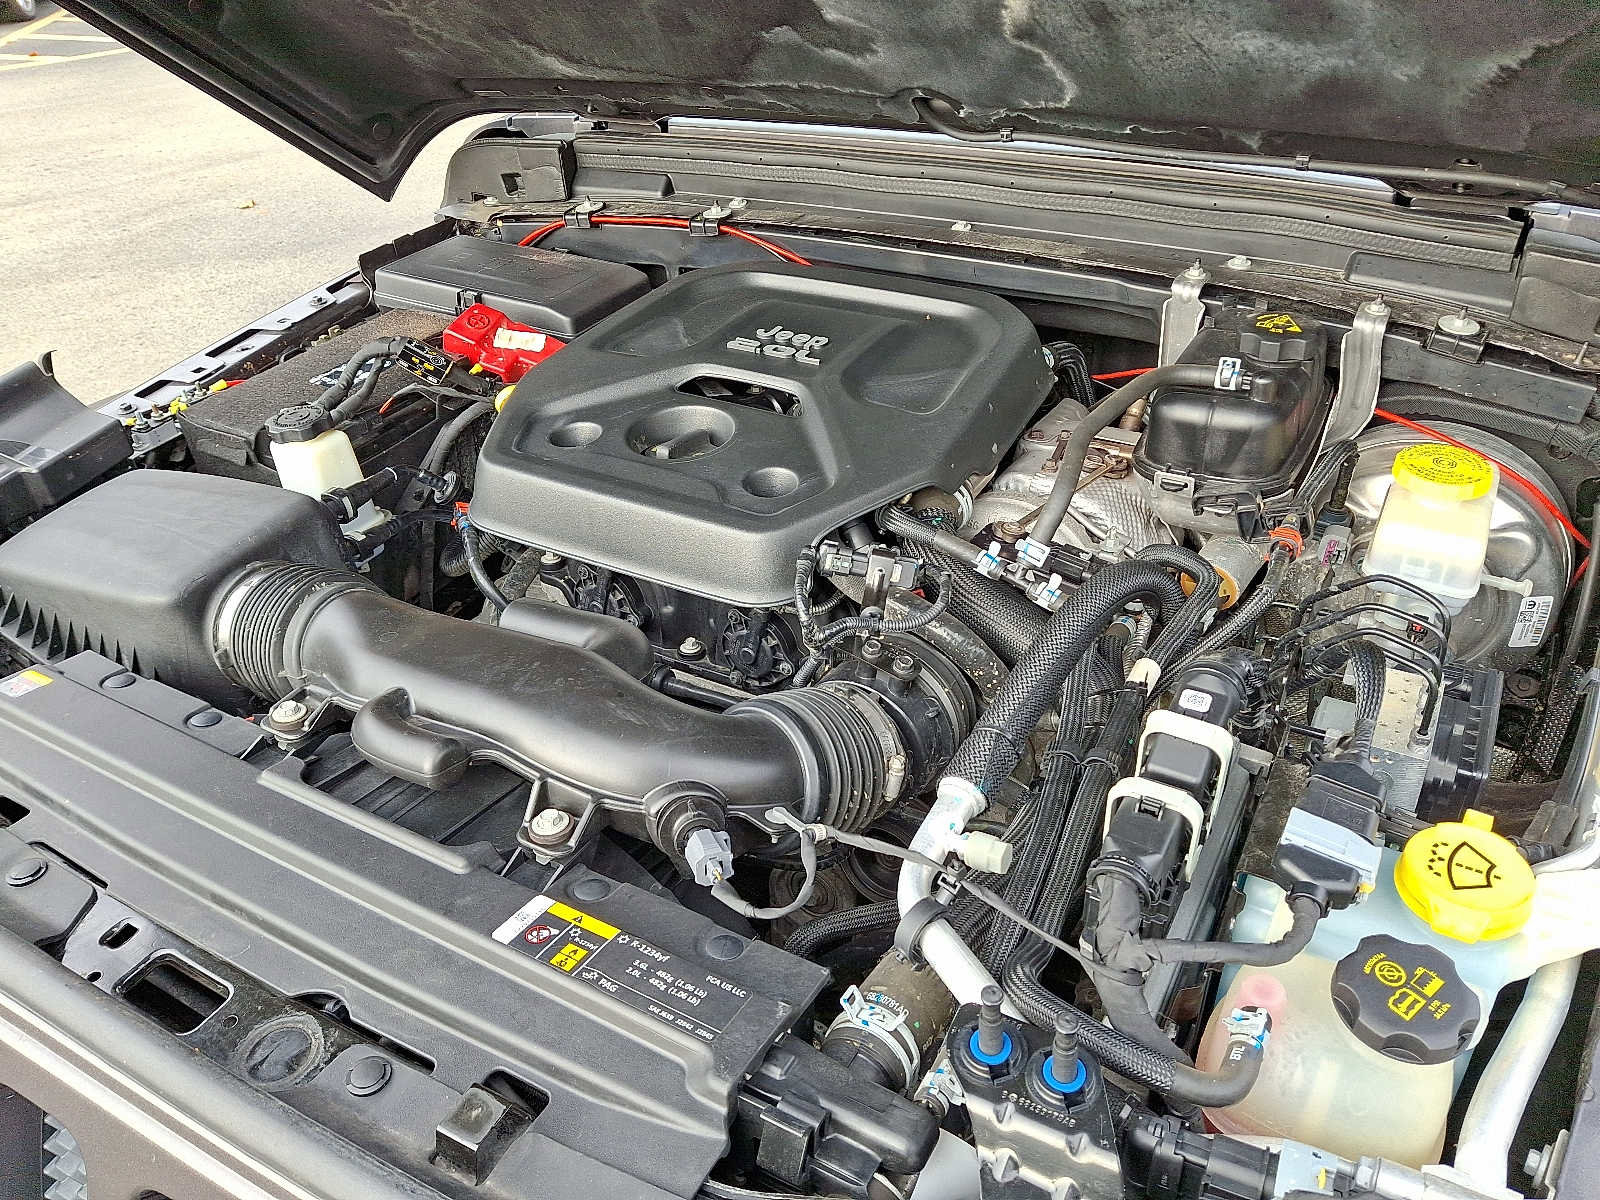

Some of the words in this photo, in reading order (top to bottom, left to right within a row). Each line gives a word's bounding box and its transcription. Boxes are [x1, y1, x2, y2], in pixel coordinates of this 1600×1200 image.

[756, 325, 829, 350] Jeep
[726, 337, 821, 366] 2.0L
[629, 938, 670, 963] R-1234yf
[597, 977, 619, 994] PAG
[625, 965, 642, 981] 2.0L
[649, 976, 668, 992] 482g
[667, 986, 688, 1001] (1.06
[686, 994, 701, 1007] Lb)
[632, 958, 649, 973] 3.6L
[656, 970, 675, 984] 482g
[674, 978, 696, 993] (1.06
[695, 987, 708, 999] Lb)
[705, 975, 721, 987] FCA
[720, 981, 734, 992] US
[731, 986, 747, 998] LLC
